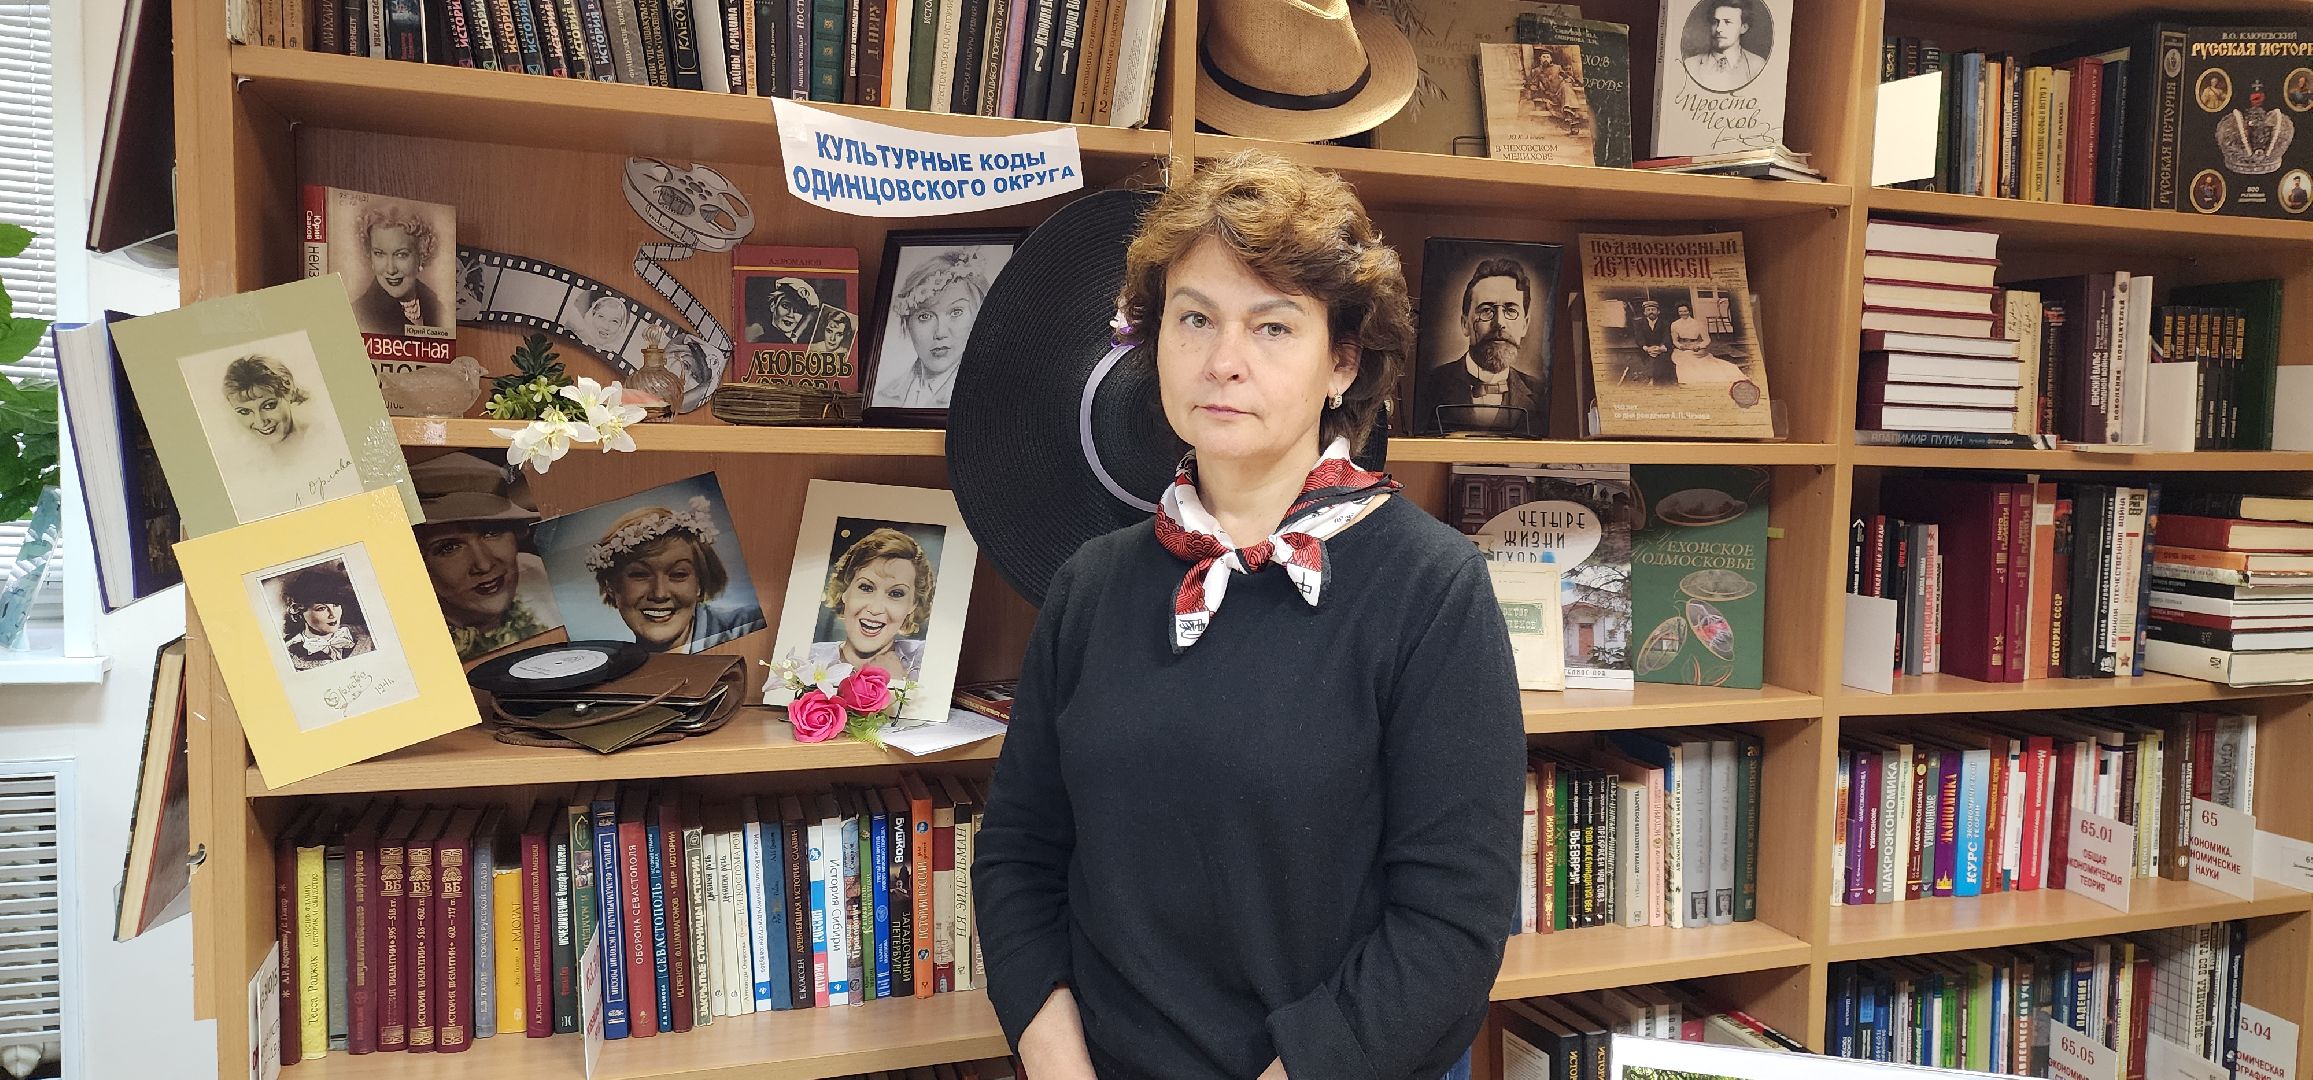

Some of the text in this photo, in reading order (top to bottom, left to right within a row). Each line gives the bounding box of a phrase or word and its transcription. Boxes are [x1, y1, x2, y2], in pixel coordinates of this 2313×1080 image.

[591, 11, 609, 65] ИСТОРИЯ
[867, 2, 881, 44] НЕРУ
[991, 18, 1003, 60] ПОРТРЕТЫ
[1034, 8, 1052, 72] 2 История
[1060, 10, 1079, 75] 1 История
[2222, 31, 2297, 40] В.О. КЛЮЧЕВСКИЙ
[620, 26, 634, 79] ФРАНЦУЗСКИЕ
[727, 7, 742, 87] ТАЙНЫ АРКАИМА
[2191, 42, 2256, 60] РУССКАЯ
[747, 78, 755, 90] НА
[936, 37, 950, 106] ХРЕСТОМАТИЯ ПО
[962, 71, 971, 106] ИСТОРИЯ
[1079, 101, 1087, 114] 1
[1099, 99, 1107, 113] 2
[1676, 93, 1757, 120] Просто
[1696, 109, 1760, 130] Чехов
[815, 131, 1046, 172] КУЛЬТУРНЫЕ КОДЫ
[1503, 144, 1558, 152] ЧЕХОВСКОМ
[1503, 152, 1553, 161] МЕЛИХОВЕ
[2159, 80, 2176, 204] РУССКАЯ ИСТОРИЯ
[792, 165, 1076, 205] ОДИНЦОВСКОГО ОКРУГА
[313, 215, 323, 240] Юрий
[1590, 239, 1738, 254] ПОДМОСКОВНЫЙ
[1592, 255, 1713, 278] ЛЕТОПИСЕЦ
[406, 327, 448, 337] Юрий Сааков
[741, 349, 854, 383] ЛЮБОВЬ
[2090, 352, 2101, 406] ВЕНСКИЙ ВАЛЬС
[2114, 299, 2125, 421] ПОКОЛЕНИЯ ПОБЕДИТЕЛЕЙ
[2099, 352, 2109, 414] ХОЛОДНОЙ ВОЙНЫ
[1871, 432, 1963, 446] ВЛАДИМИР ПУТИН
[1504, 530, 1566, 549] ЖИЗНИ
[1518, 510, 1585, 529] ЧЕТЫРЕ
[1876, 524, 1884, 552] ПОБЕДЫ
[2110, 497, 2126, 649] ВЕЛИКАЯ ОТЕЧЕСТВЕННАЯ ВОЙНА
[1923, 544, 1935, 664] СТАЛИНГРАДСКАЯ ЭПОПЕЯ
[2052, 593, 2063, 666] ИСТОРИЯ СССР
[1858, 771, 1867, 822] МАКРОЭКОНОМИКА
[2184, 762, 2192, 802] МАТЕМАТИКА
[1654, 803, 1662, 837] ИСТОРИЯ
[1882, 761, 1897, 893] МАКРОЭКОНОМИКА
[1914, 778, 1924, 852] МАКРОЭКОНОМИКА
[1923, 795, 1936, 849] ЭКОНОМИКА
[1940, 773, 1957, 845] ЭКОНОМИКА
[1966, 761, 1978, 885] КУРС ЭКОНОМИЧЕСКОЙ
[2202, 810, 2218, 827] 65
[1545, 814, 1554, 887] ИСТОРИЯ РОССИИ
[1584, 825, 1594, 843] ТВОЙ
[2080, 819, 2112, 843] 65.01
[531, 844, 539, 871] АМЕРИКИ
[668, 831, 678, 888] МИР ИСТОРИИ
[957, 827, 970, 913] ЭЙДЕЛЬМАН
[1569, 830, 1581, 885] ВЬЕВАРУМ
[1597, 825, 1605, 883] ПРЕКРАСЕН НАШ
[2069, 858, 2122, 886] КОНОМИЧЕСКАЯ
[2083, 848, 2107, 866] ОБЩАЯ
[2196, 865, 2219, 880] НАУКИ
[384, 880, 402, 891] ВБ
[412, 881, 431, 891] ВБ
[443, 881, 461, 892] ВБ
[531, 871, 540, 904] ЛАТИНСКОЙ
[628, 844, 644, 965] ОБОРОНА СЕВАСТОПОЛЯ
[918, 861, 928, 939] ИСТОРИЯ РОССИИ
[2080, 874, 2106, 893] ТЕОРИЯ
[511, 902, 521, 942] МЮРАТ
[555, 872, 570, 946] ИСЧЕЗНОВЕНИЕ Йозефа
[790, 829, 807, 1000] Е.КЛАССЕН ДРЕВНЕЙШАЯ ИСТОРИЯ СЛАВЯН
[829, 858, 844, 952] История Сибири
[1584, 898, 1594, 913] ВЕК
[479, 862, 489, 996] ТАРЛЕ ГОРОД РУССКОЙ СЛАВЫ
[532, 923, 541, 950] ИСТОРИЯ
[652, 883, 667, 973] СЕВАСТОПОЛЬ
[691, 855, 709, 1017] ЗАКРЫТЫЕ СТРАНИЦЫ ИСТОРИИ
[892, 920, 902, 976] ПЕТЕРБУРГ
[902, 911, 911, 982] ЗАГАДОЧНЫЙ
[388, 944, 397, 986] ВИЗАНТИИ
[607, 936, 618, 996] ИСТОРИИ РОССИИ
[812, 909, 825, 992] ИСТОРИЯ РОССИИ
[307, 955, 319, 1025] Тесса Раджак
[416, 945, 427, 1027] ИСТОРИЯ ВИЗАНТИИ
[447, 946, 457, 1027] ИСТОРИЯ ВИЗАНТИИ
[2076, 980, 2087, 1027] ПАДЕНИЯ
[2194, 958, 2208, 1038] ЭКОНОМИКА БЕЗ
[2061, 1036, 2094, 1065] 65.05
